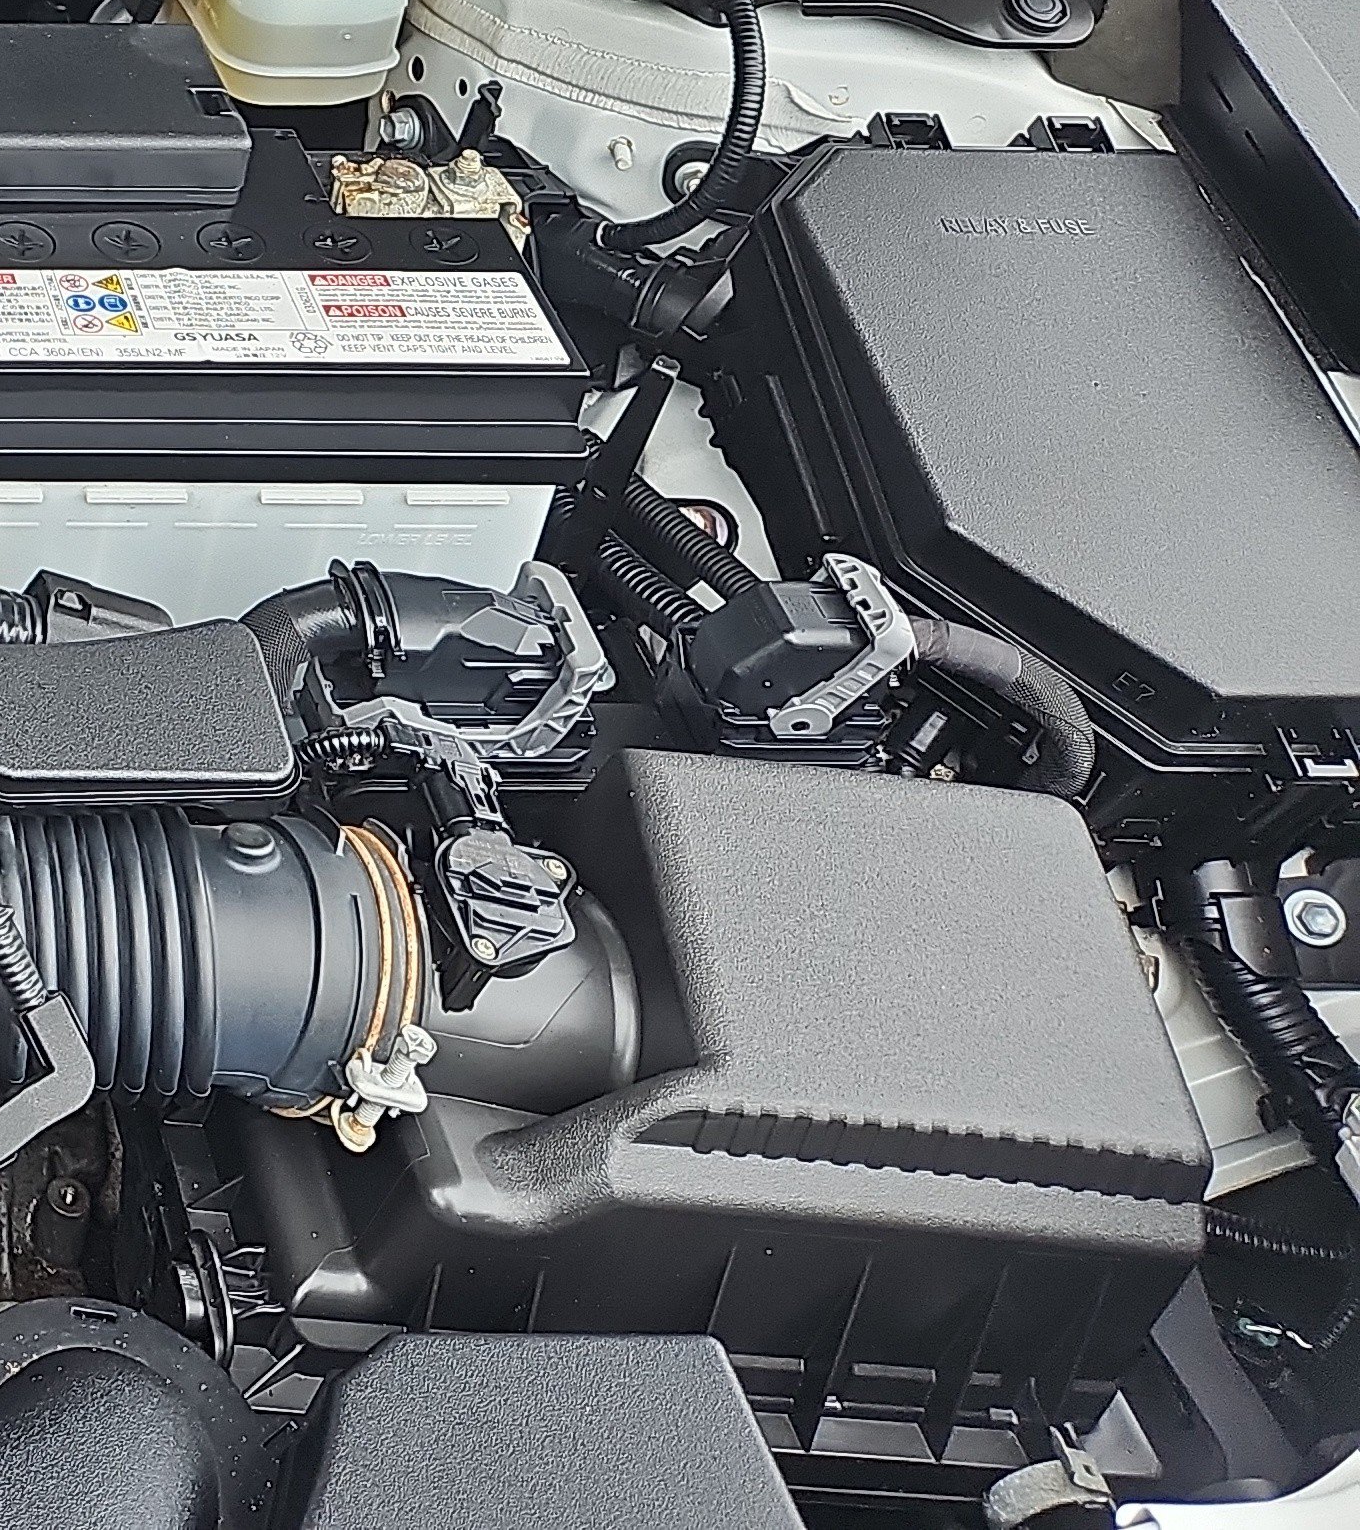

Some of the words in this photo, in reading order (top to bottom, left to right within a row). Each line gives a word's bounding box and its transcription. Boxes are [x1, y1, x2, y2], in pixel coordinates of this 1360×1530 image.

[940, 217, 1008, 235] RELAY
[1015, 218, 1031, 234] &
[1035, 219, 1096, 235] FUSE
[327, 275, 386, 286] DANGER
[391, 276, 467, 287] EXPLOSIVE
[471, 276, 519, 288] GASES
[342, 305, 403, 317] POISON
[406, 306, 451, 318] CAUSES
[453, 306, 496, 318] SEVERE
[497, 306, 537, 319] BURNS
[337, 333, 350, 342] DO
[351, 334, 370, 342] NOT
[370, 333, 384, 342] TIP
[389, 333, 412, 342] KEEP
[413, 334, 431, 343] OUT
[433, 335, 446, 343] OF
[446, 335, 464, 343] THE
[464, 335, 495, 343] REACH
[509, 336, 553, 344] CHILDREN
[8, 347, 40, 357] CCA
[43, 347, 104, 358] 360A(EN)
[115, 347, 186, 358] 355LN2-MF
[341, 343, 367, 352] KEEP
[369, 344, 396, 353] VENT
[398, 344, 427, 353] CAPS
[427, 345, 459, 354] TIGHT
[461, 345, 483, 354] AND
[484, 346, 517, 354] LEVEL
[1111, 670, 1157, 703] E7
